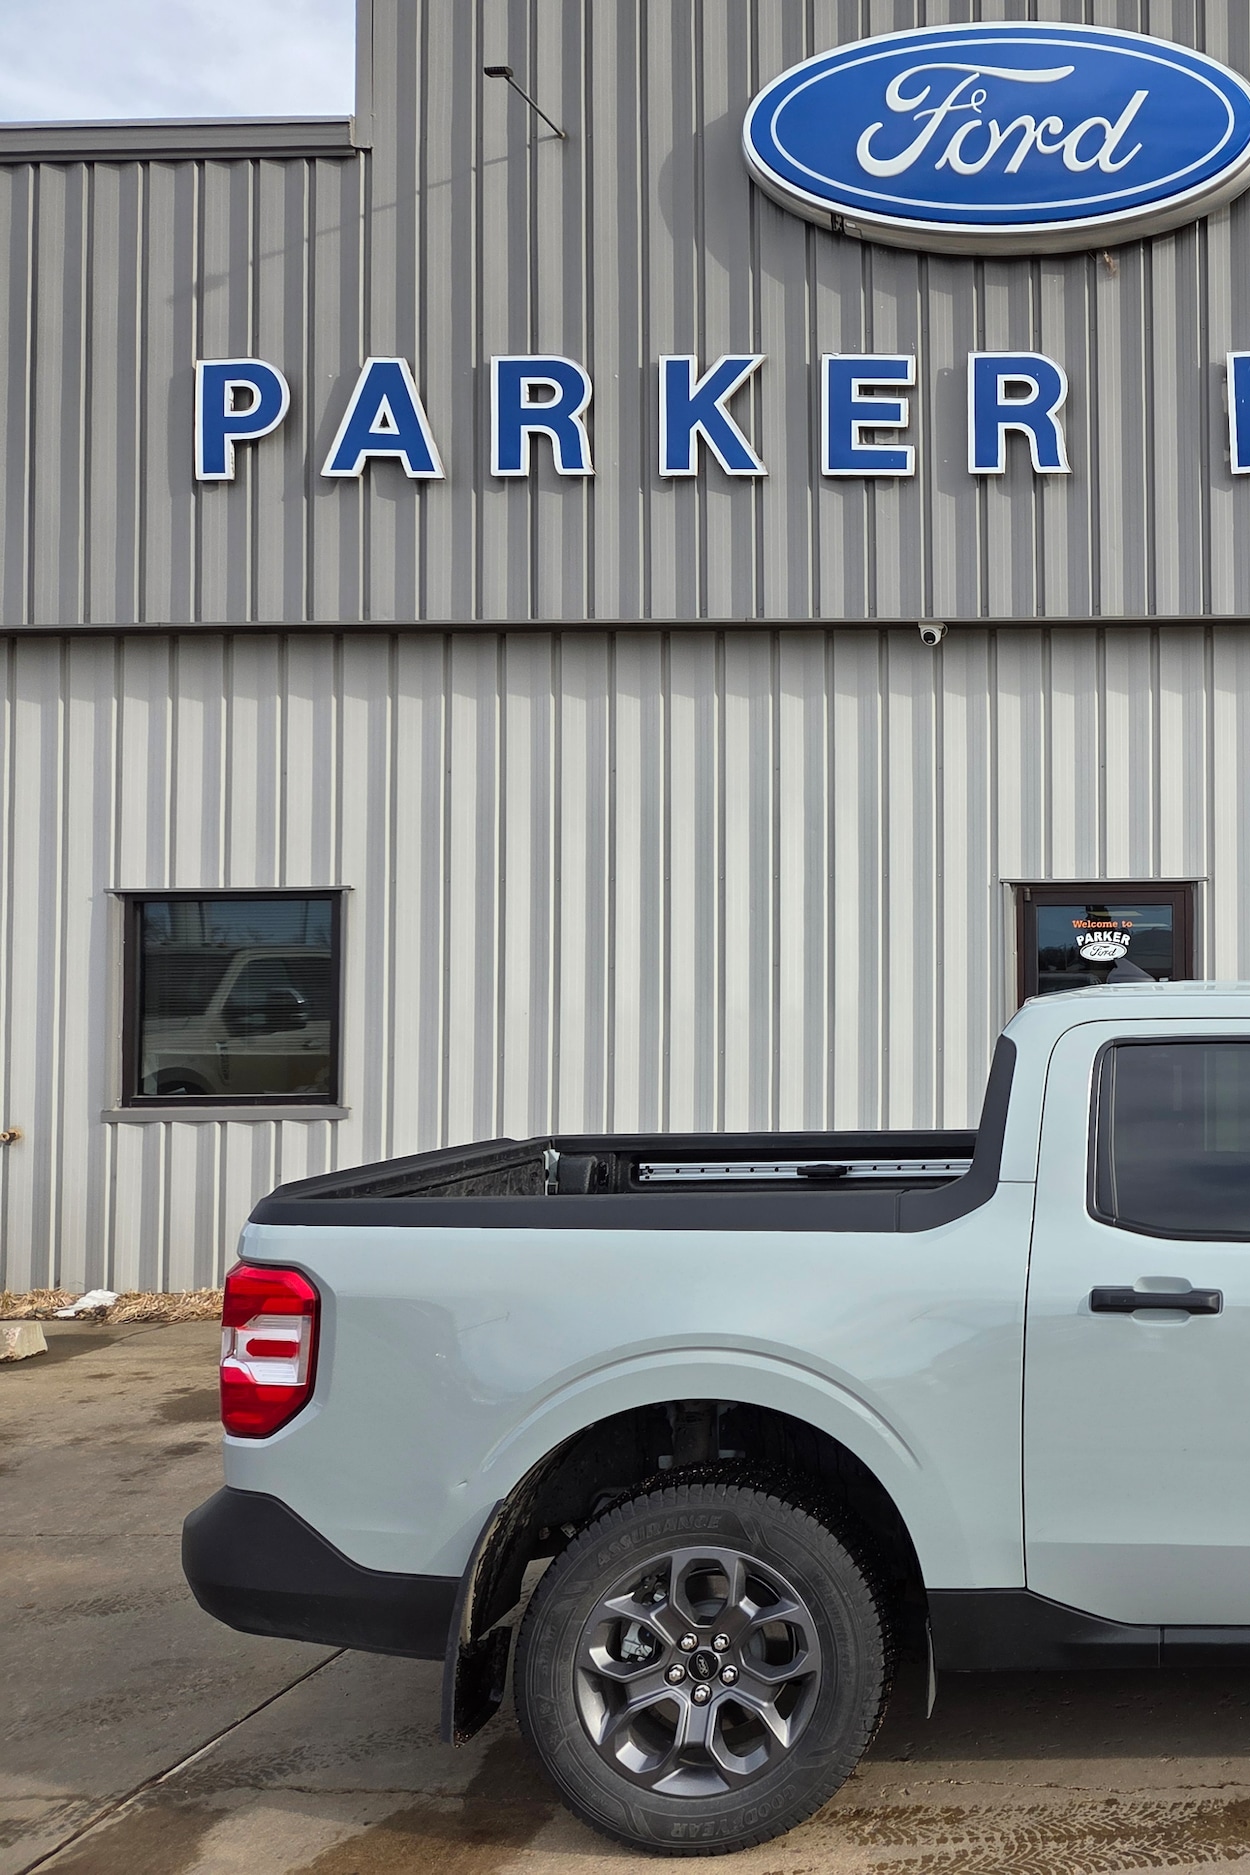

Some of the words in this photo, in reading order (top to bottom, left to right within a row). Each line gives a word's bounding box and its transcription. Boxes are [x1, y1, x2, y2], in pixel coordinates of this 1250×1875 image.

[856, 62, 1149, 178] Ford
[193, 351, 1071, 483] PARKER
[1071, 919, 1118, 929] Welcome
[1121, 920, 1133, 928] to
[1075, 930, 1131, 947] PARKER
[1089, 945, 1117, 957] Ford
[597, 1514, 722, 1566] ASSURANCE
[670, 1784, 797, 1839] GOODYEAR
